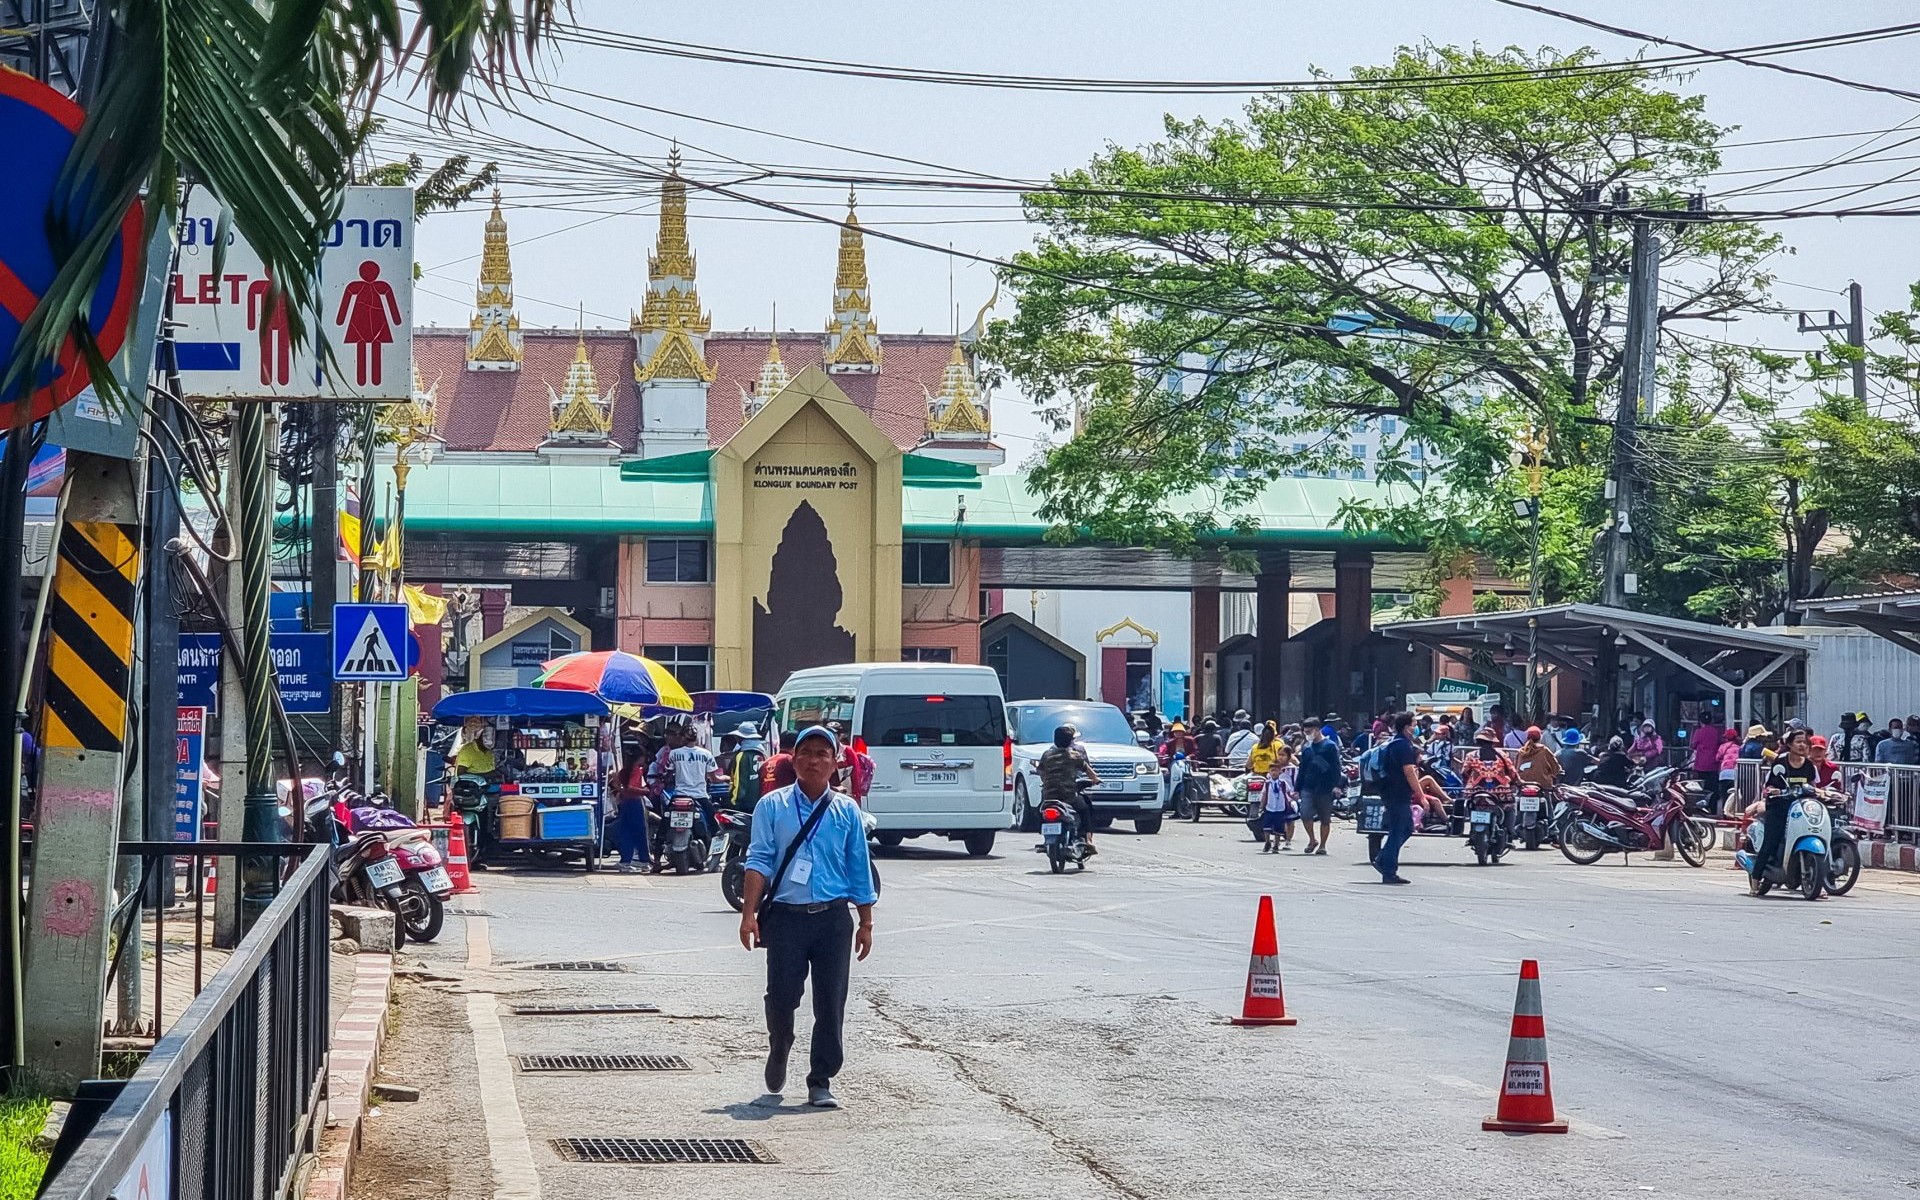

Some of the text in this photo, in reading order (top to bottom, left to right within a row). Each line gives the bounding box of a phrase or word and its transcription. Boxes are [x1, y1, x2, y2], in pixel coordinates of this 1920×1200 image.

[754, 480, 858, 490] KLONGLUK BOUNDARY POST
